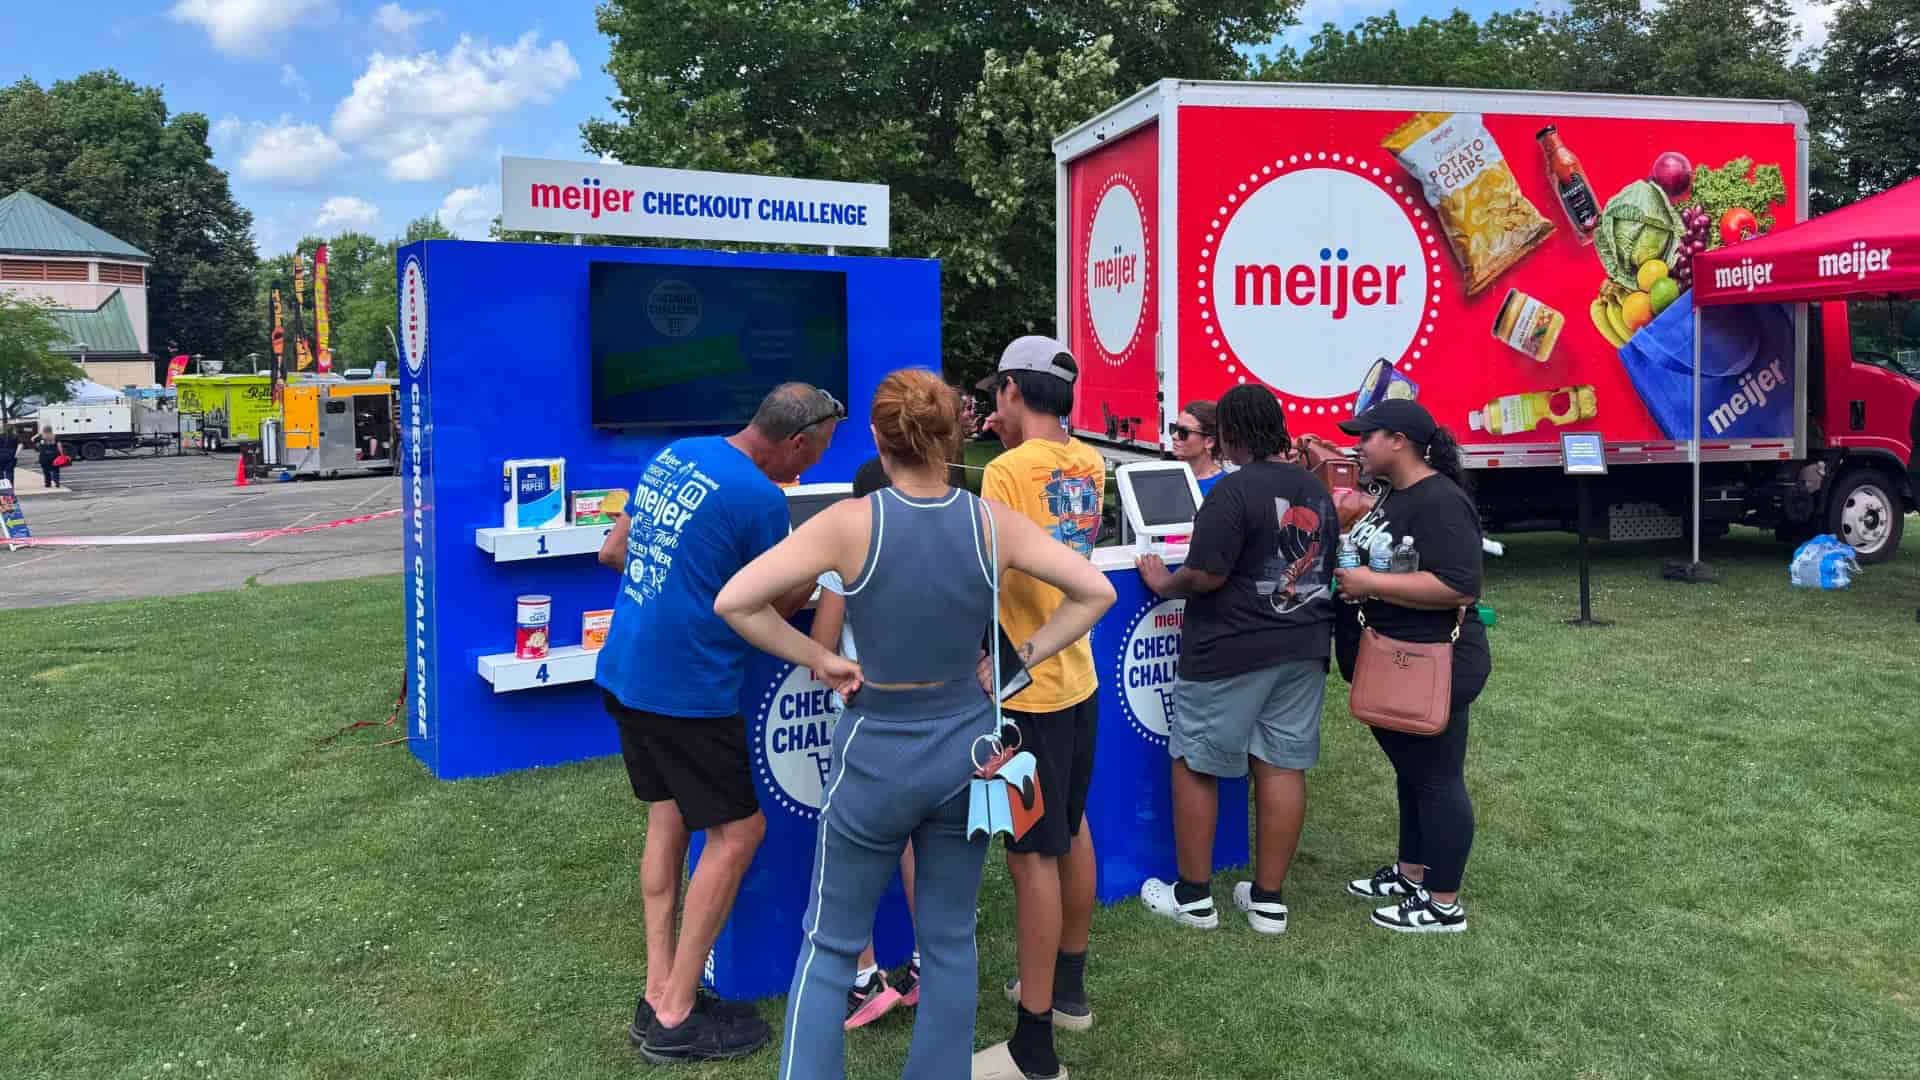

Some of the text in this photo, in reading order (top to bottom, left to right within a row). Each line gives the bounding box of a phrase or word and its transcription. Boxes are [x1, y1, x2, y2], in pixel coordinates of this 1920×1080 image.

[1428, 138, 1484, 183] POTATO
[1443, 154, 1486, 189] CHIPS
[531, 178, 867, 226] meijer CHECKOUT CHALLENGE
[1094, 245, 1137, 293] meijer
[1234, 247, 1406, 319] meijer
[1715, 257, 1774, 292] meijer
[1818, 241, 1892, 280] meijer
[1707, 356, 1787, 434] meijer
[411, 383, 423, 549] CHECKOUT
[634, 482, 693, 533] meijer
[537, 535, 549, 554] 1
[415, 555, 427, 740] CHALLENGE
[536, 664, 549, 683] 4
[780, 688, 835, 721] CHEC
[771, 721, 831, 754] CHAL
